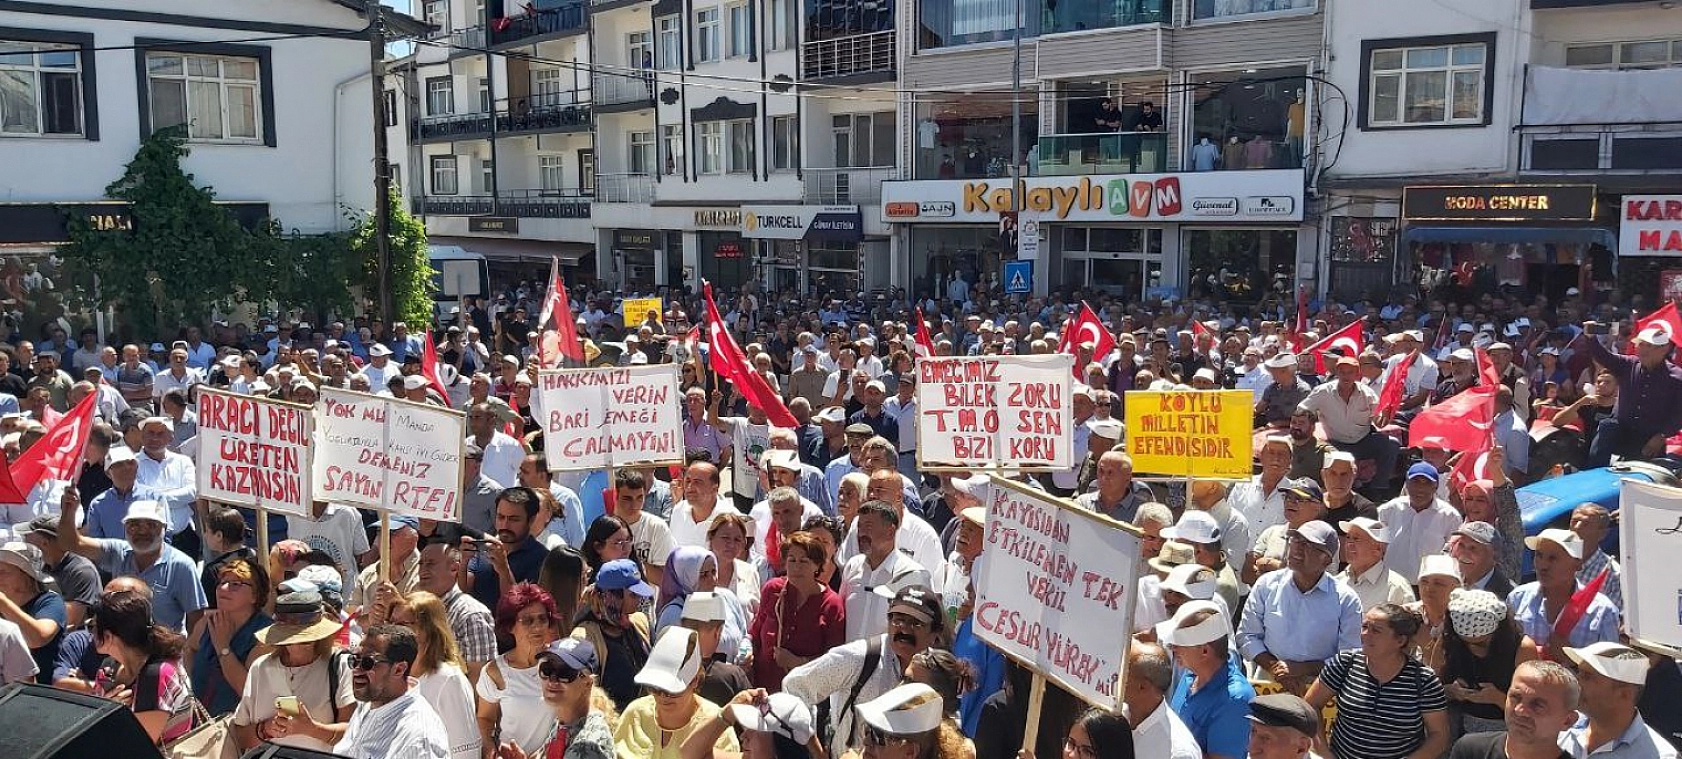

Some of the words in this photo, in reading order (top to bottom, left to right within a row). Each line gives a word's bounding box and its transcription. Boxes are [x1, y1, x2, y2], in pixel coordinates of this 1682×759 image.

[1110, 184, 1179, 213] AVM
[1489, 196, 1549, 210] CENTER
[757, 215, 803, 228] TURKCELL
[612, 385, 667, 405] VERİN
[1007, 383, 1061, 409] ZORU
[1160, 391, 1222, 413] KÖYLÜ
[324, 398, 356, 418] YOK
[361, 406, 386, 423] MU
[923, 408, 999, 433] T.M.O
[1017, 409, 1062, 435] SEN
[220, 435, 299, 474] ÜRETEN
[1009, 436, 1056, 460] KORU
[358, 448, 431, 479] DEMENİZ
[323, 465, 383, 498] SAYIN
[393, 481, 456, 519] RTE!
[1082, 571, 1124, 610] TEK
